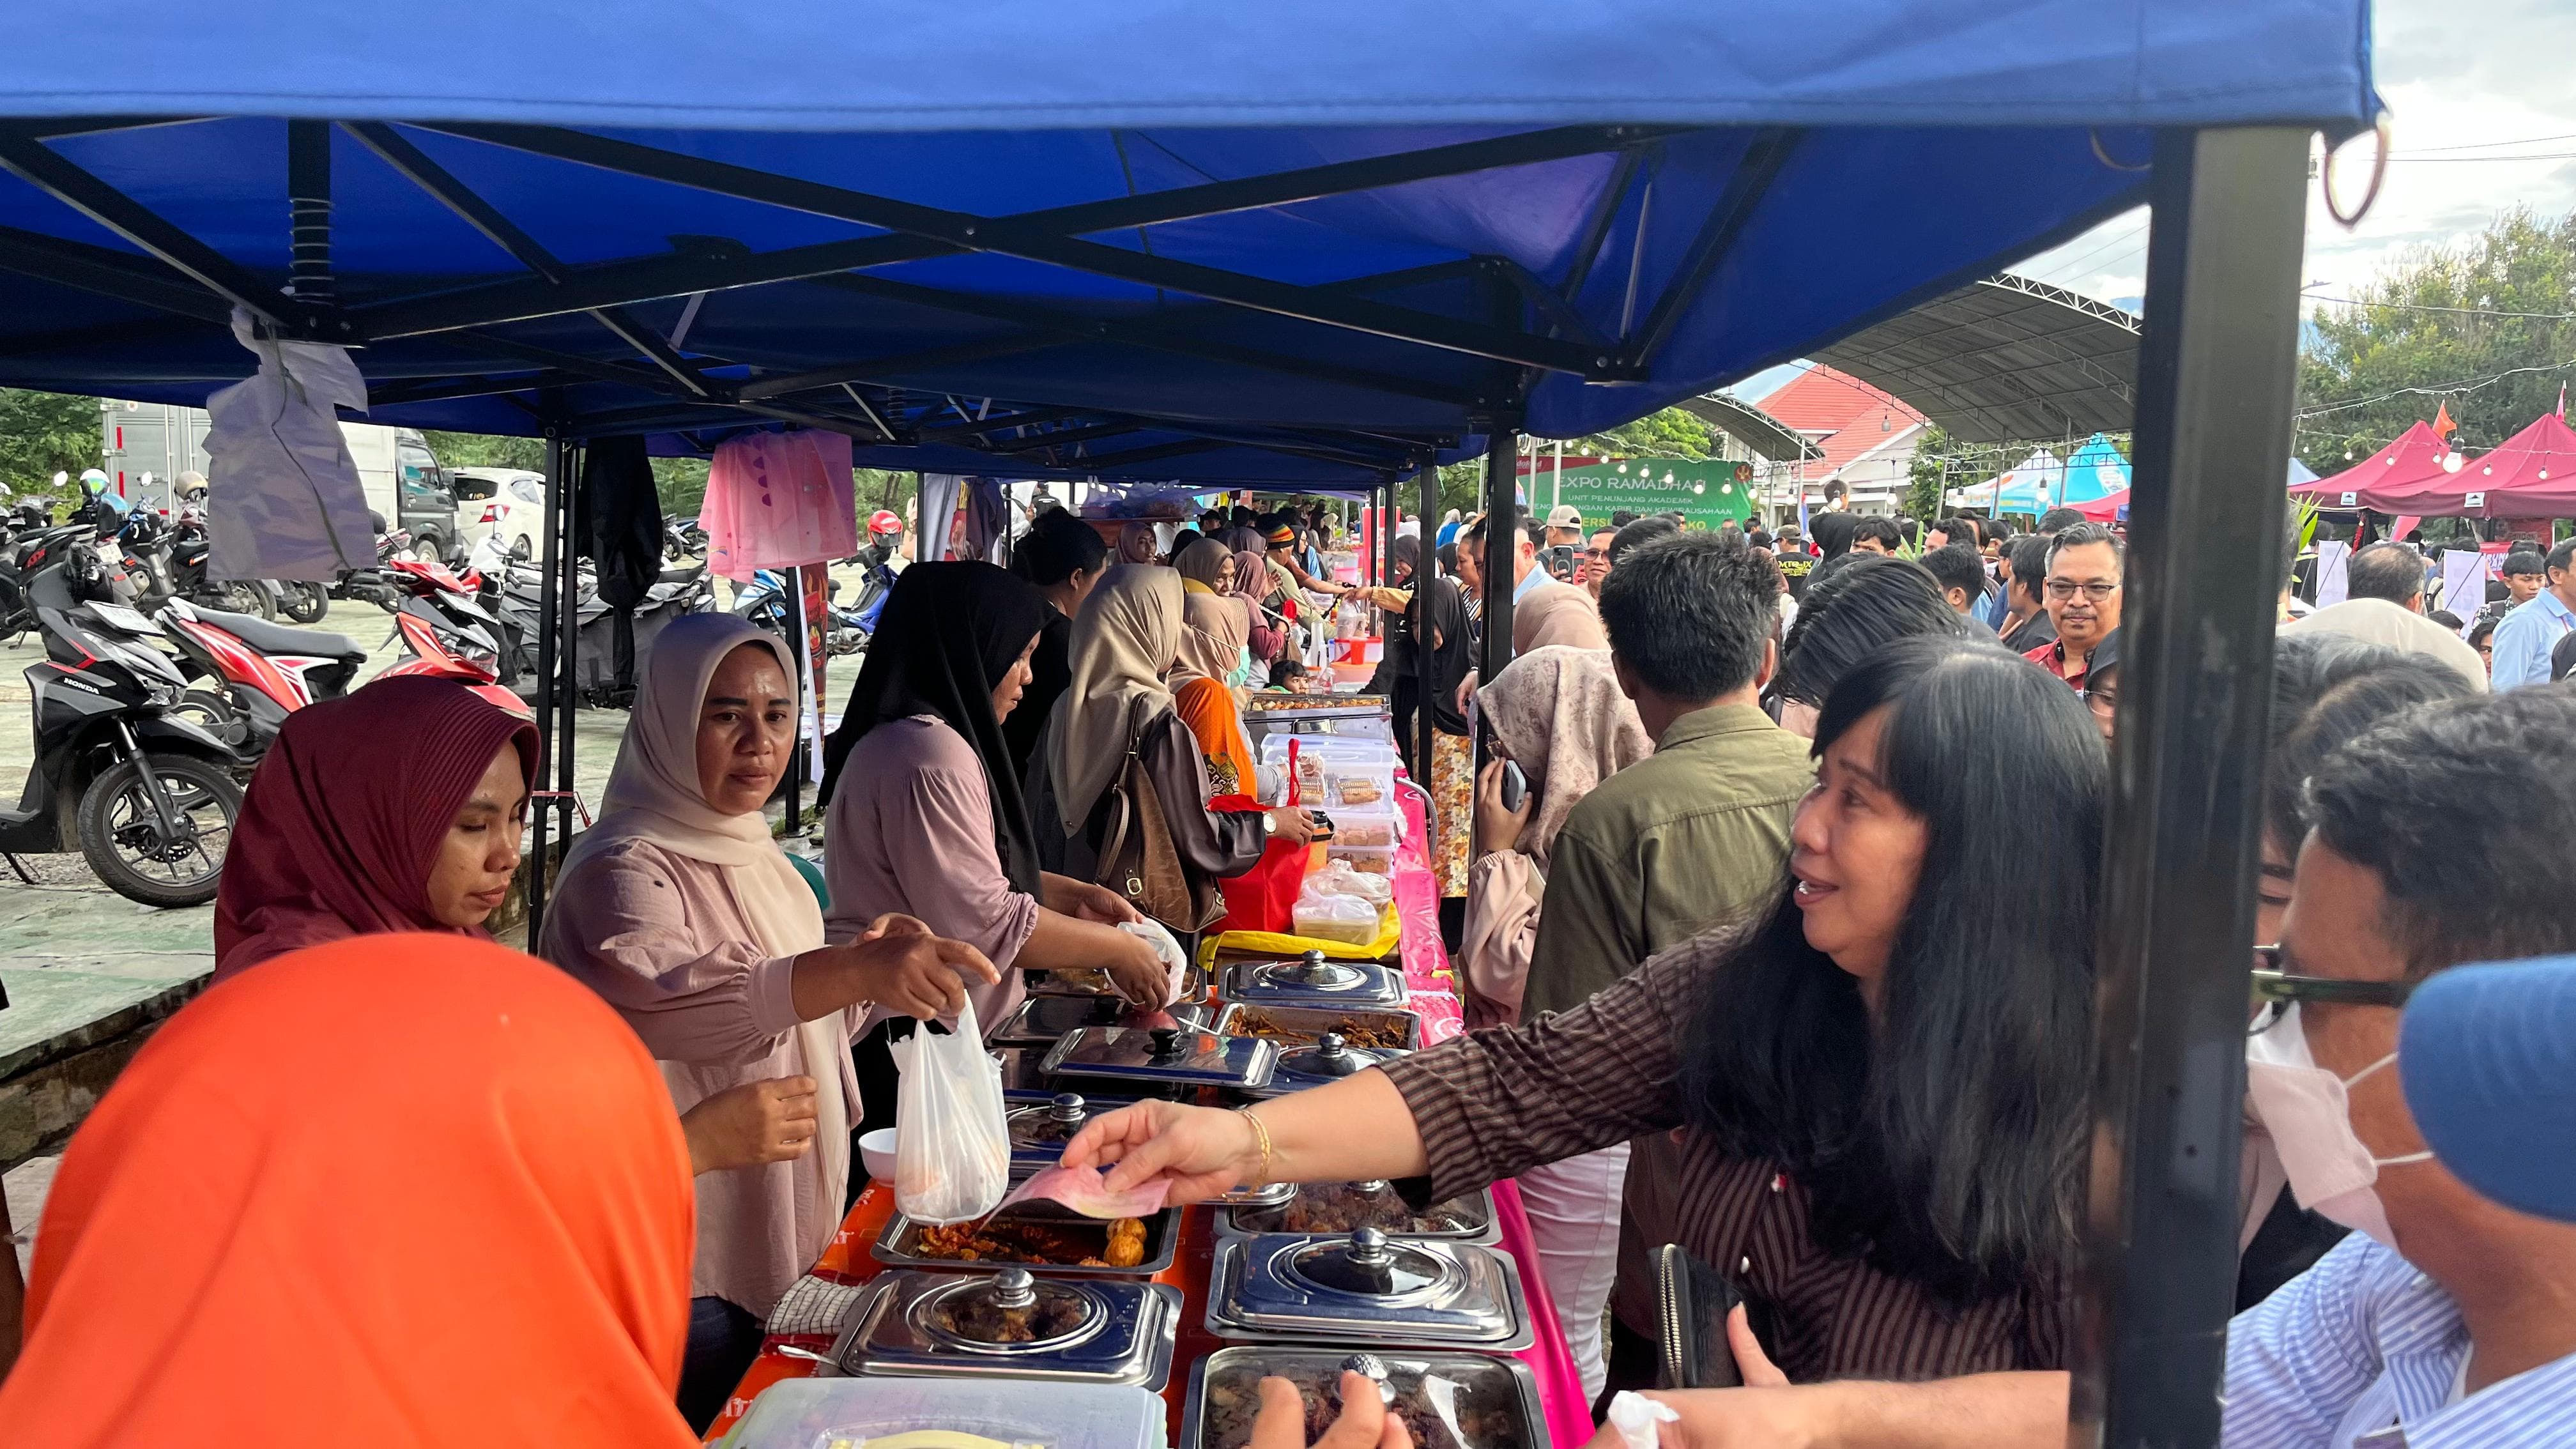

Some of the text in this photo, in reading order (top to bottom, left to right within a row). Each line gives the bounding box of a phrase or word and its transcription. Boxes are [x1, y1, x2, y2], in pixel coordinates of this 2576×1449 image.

[1560, 477, 1602, 488] EXPO
[1591, 494, 1646, 503] PENUNJANG
[1655, 507, 1733, 515] KEWIRAUSAHAAN
[63, 677, 100, 694] HONDA
